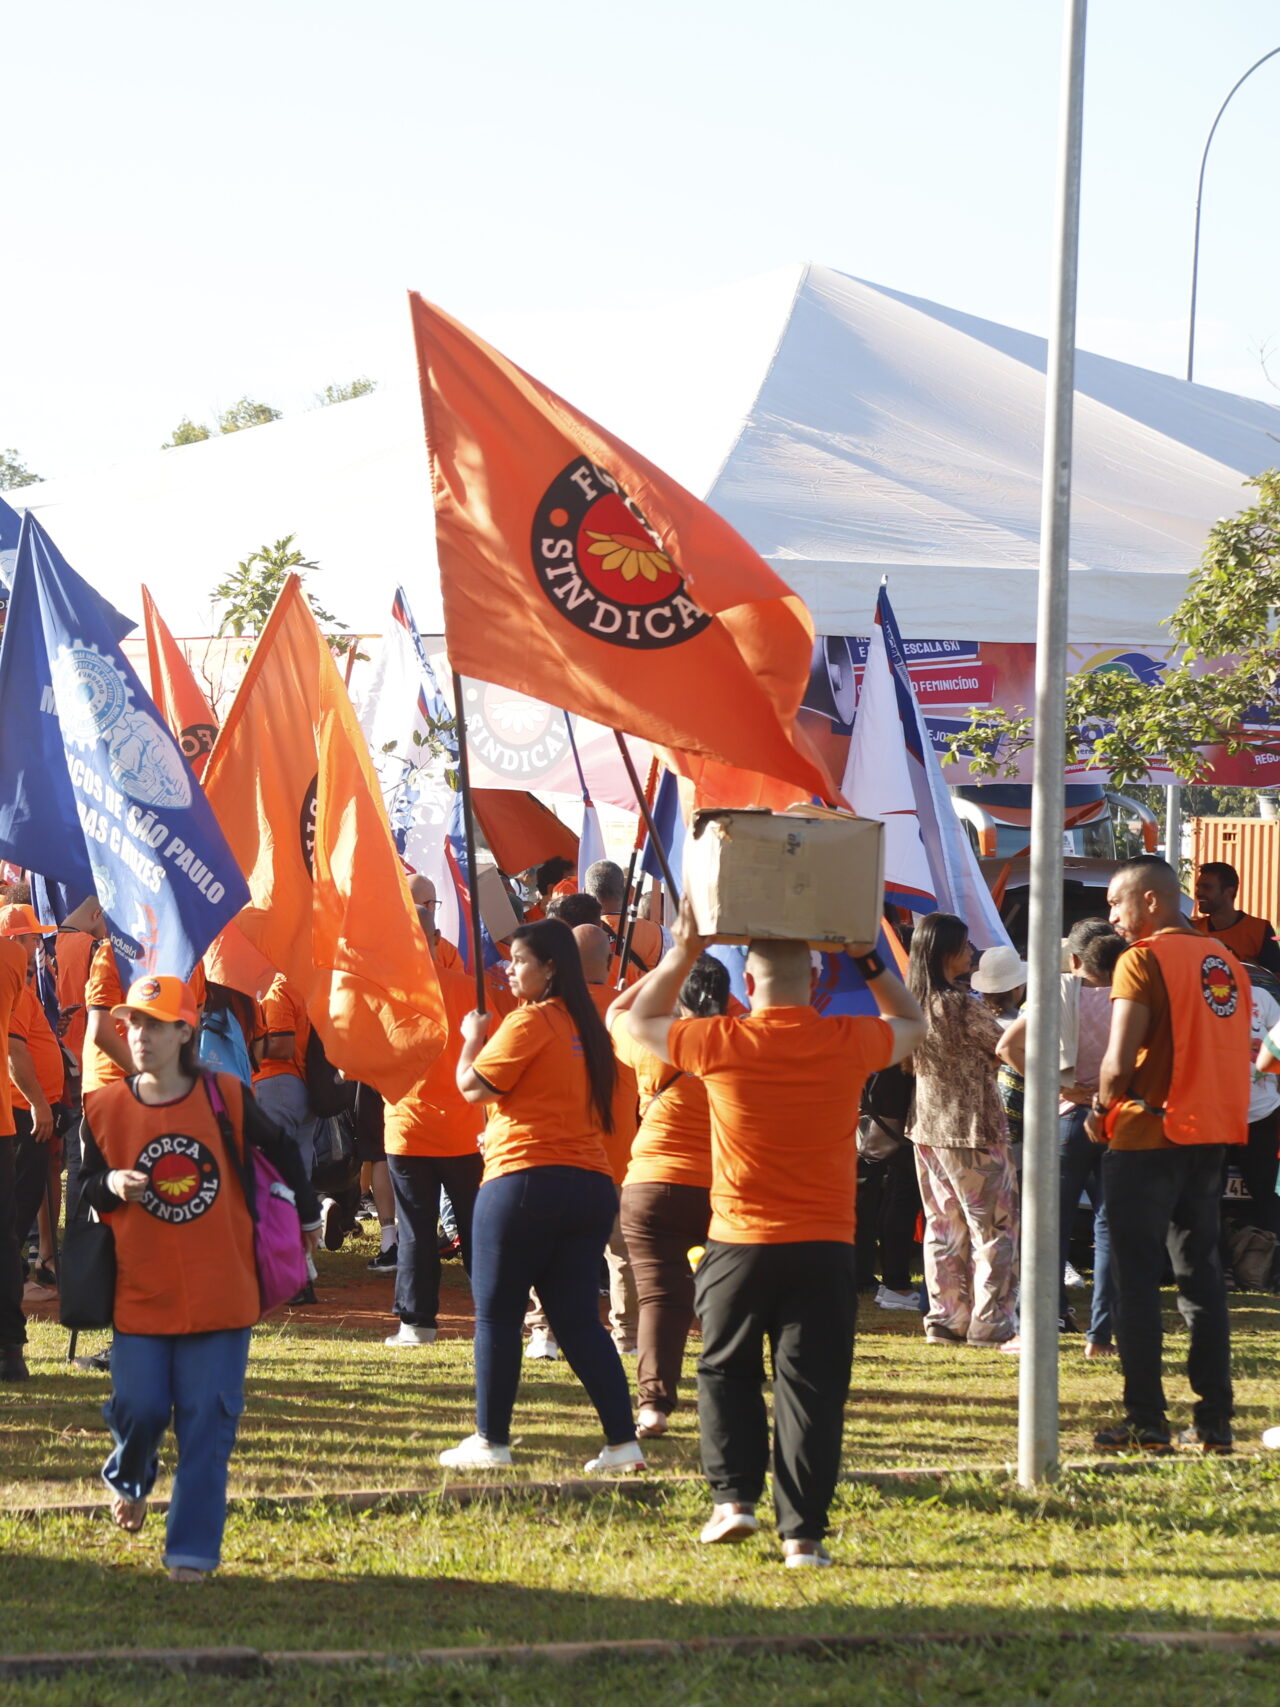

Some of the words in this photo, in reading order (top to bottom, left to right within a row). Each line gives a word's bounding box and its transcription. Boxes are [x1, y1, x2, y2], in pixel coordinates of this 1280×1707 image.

[542, 538, 708, 640] SINDICA
[903, 641, 943, 655] ESCALA
[920, 675, 979, 693] FEMINICÍDIO
[464, 713, 568, 773] SINDICAL
[104, 784, 124, 821] DE
[126, 805, 169, 849] SÃO
[163, 837, 225, 904] PAULO
[139, 1137, 200, 1168] FORÇA
[140, 1178, 218, 1222] SINDICAL
